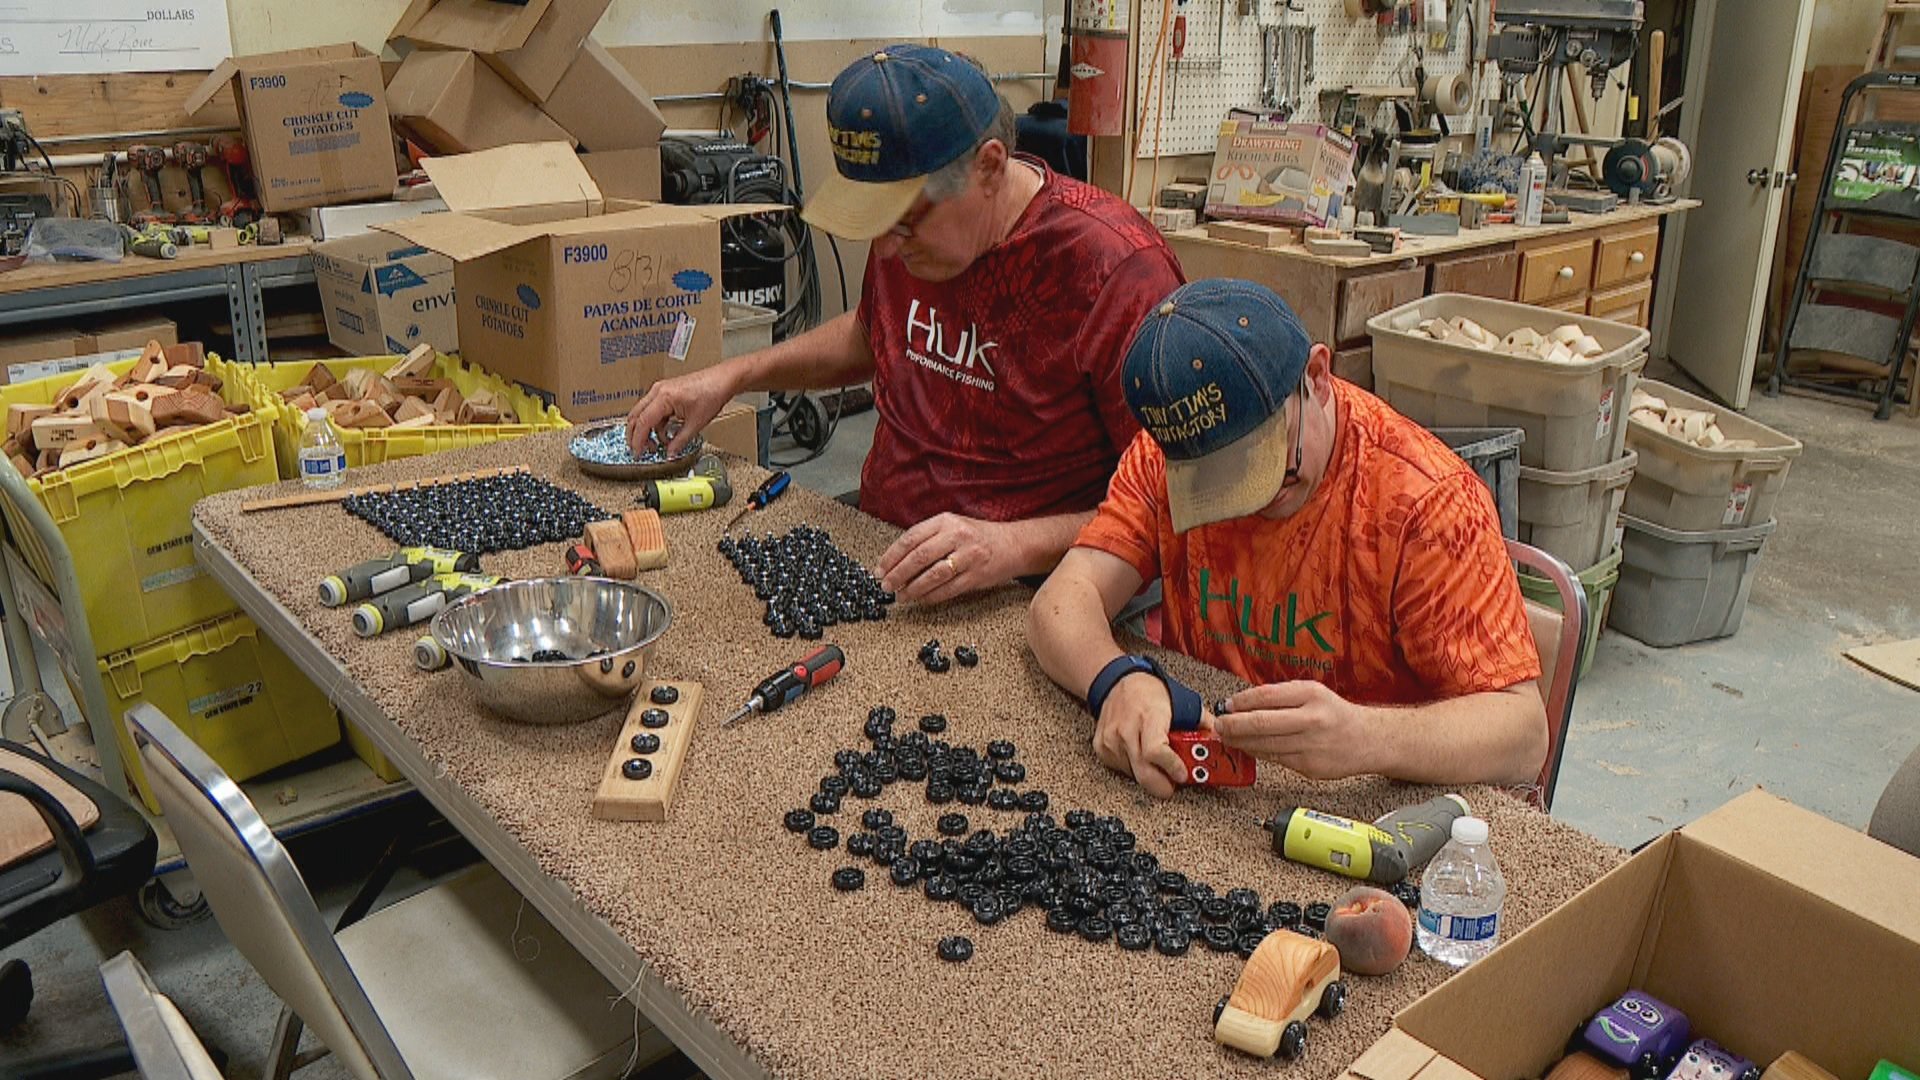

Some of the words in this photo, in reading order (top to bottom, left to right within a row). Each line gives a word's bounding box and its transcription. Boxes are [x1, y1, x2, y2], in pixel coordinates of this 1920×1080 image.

[147, 9, 195, 21] DOLLARS
[250, 75, 287, 91] F3900
[336, 108, 361, 119] CUT
[293, 121, 354, 137] POTATOES
[1232, 136, 1301, 151] DRAWSTRING
[1226, 149, 1271, 163] KITCHEN
[564, 243, 608, 264] F3900
[511, 305, 529, 323] CUT
[583, 301, 630, 319] PAPAS
[632, 298, 652, 312] DE
[655, 293, 702, 309] CORTE
[481, 313, 525, 339] POTATOES
[600, 310, 689, 333] ACANALADO
[955, 371, 995, 393] FISHING
